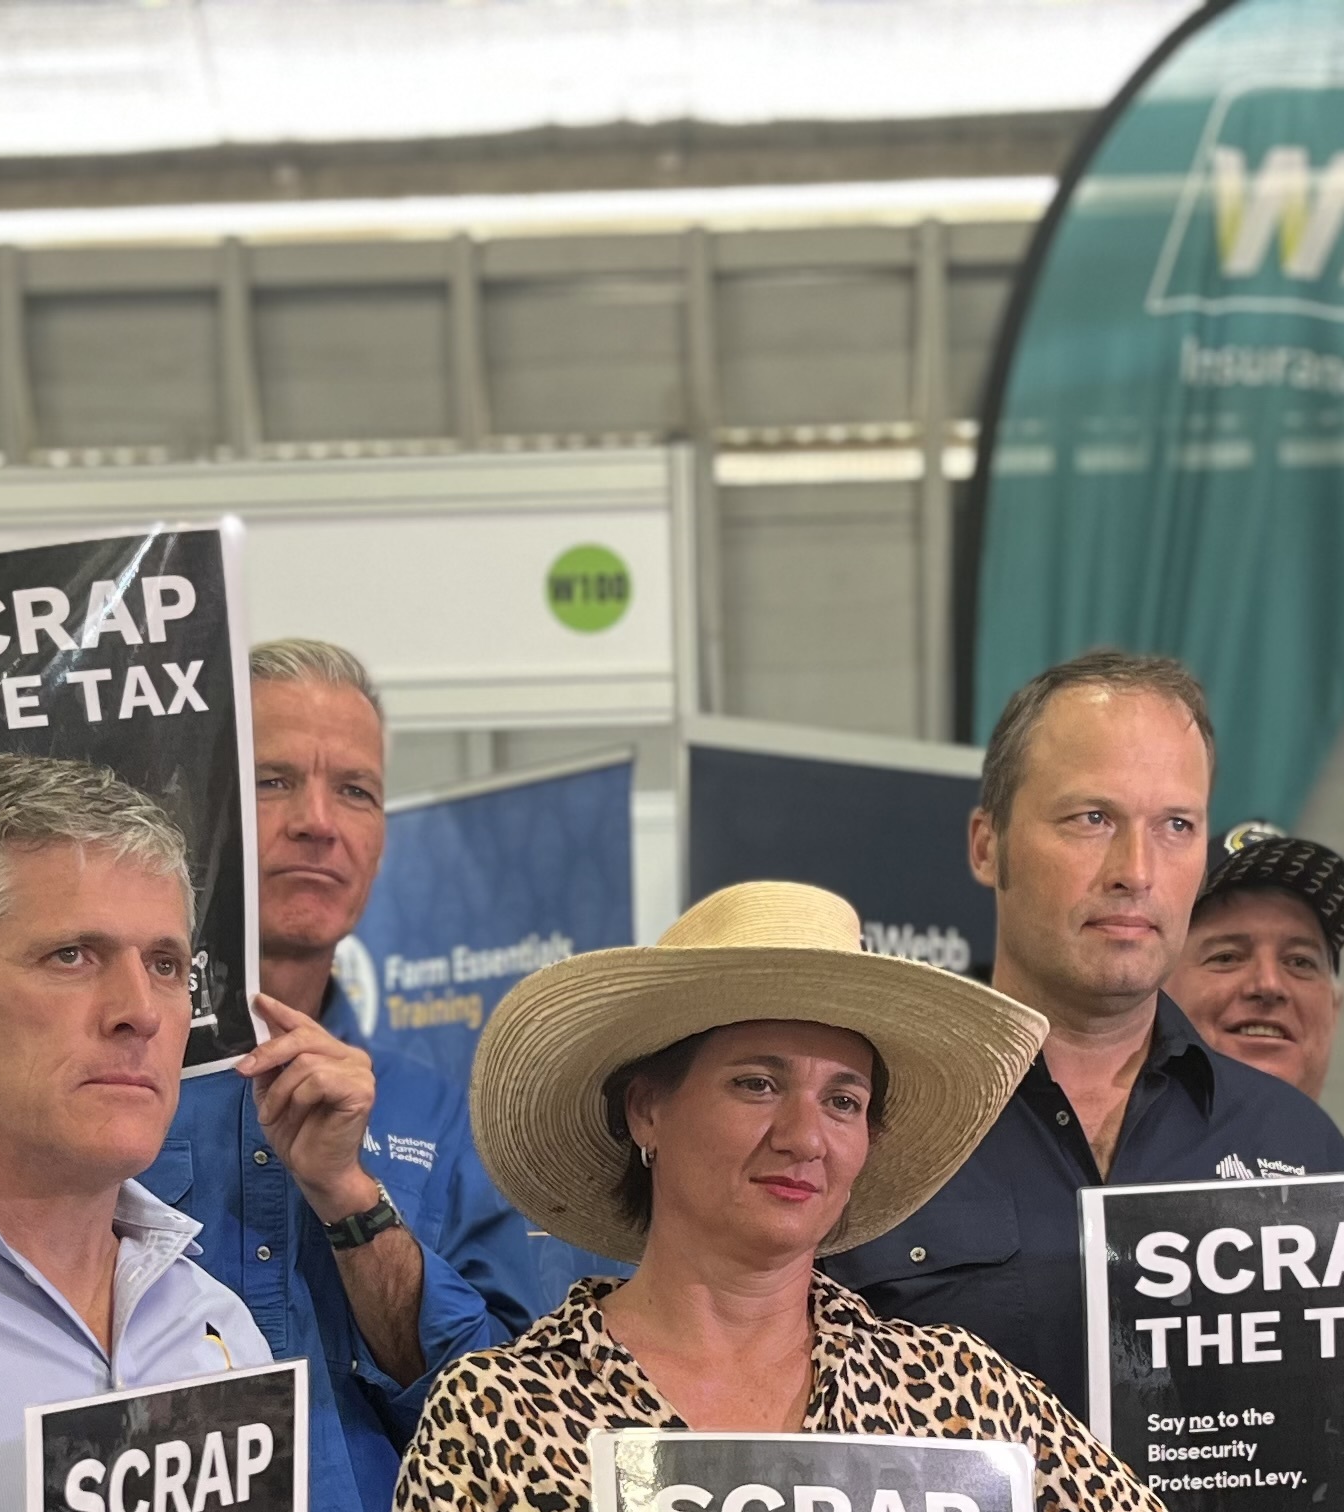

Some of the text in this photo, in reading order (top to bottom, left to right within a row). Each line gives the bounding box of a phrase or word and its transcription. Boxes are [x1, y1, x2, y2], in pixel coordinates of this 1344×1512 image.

[66, 659, 209, 723] TAX
[385, 953, 449, 991] Farm
[387, 986, 482, 1031] Training
[1257, 1158, 1305, 1176] National
[1134, 1310, 1283, 1369] THE
[1147, 1408, 1275, 1435] Say no to the
[1147, 1440, 1258, 1462] Biosecurity
[1148, 1468, 1307, 1492] Protection Levy.
